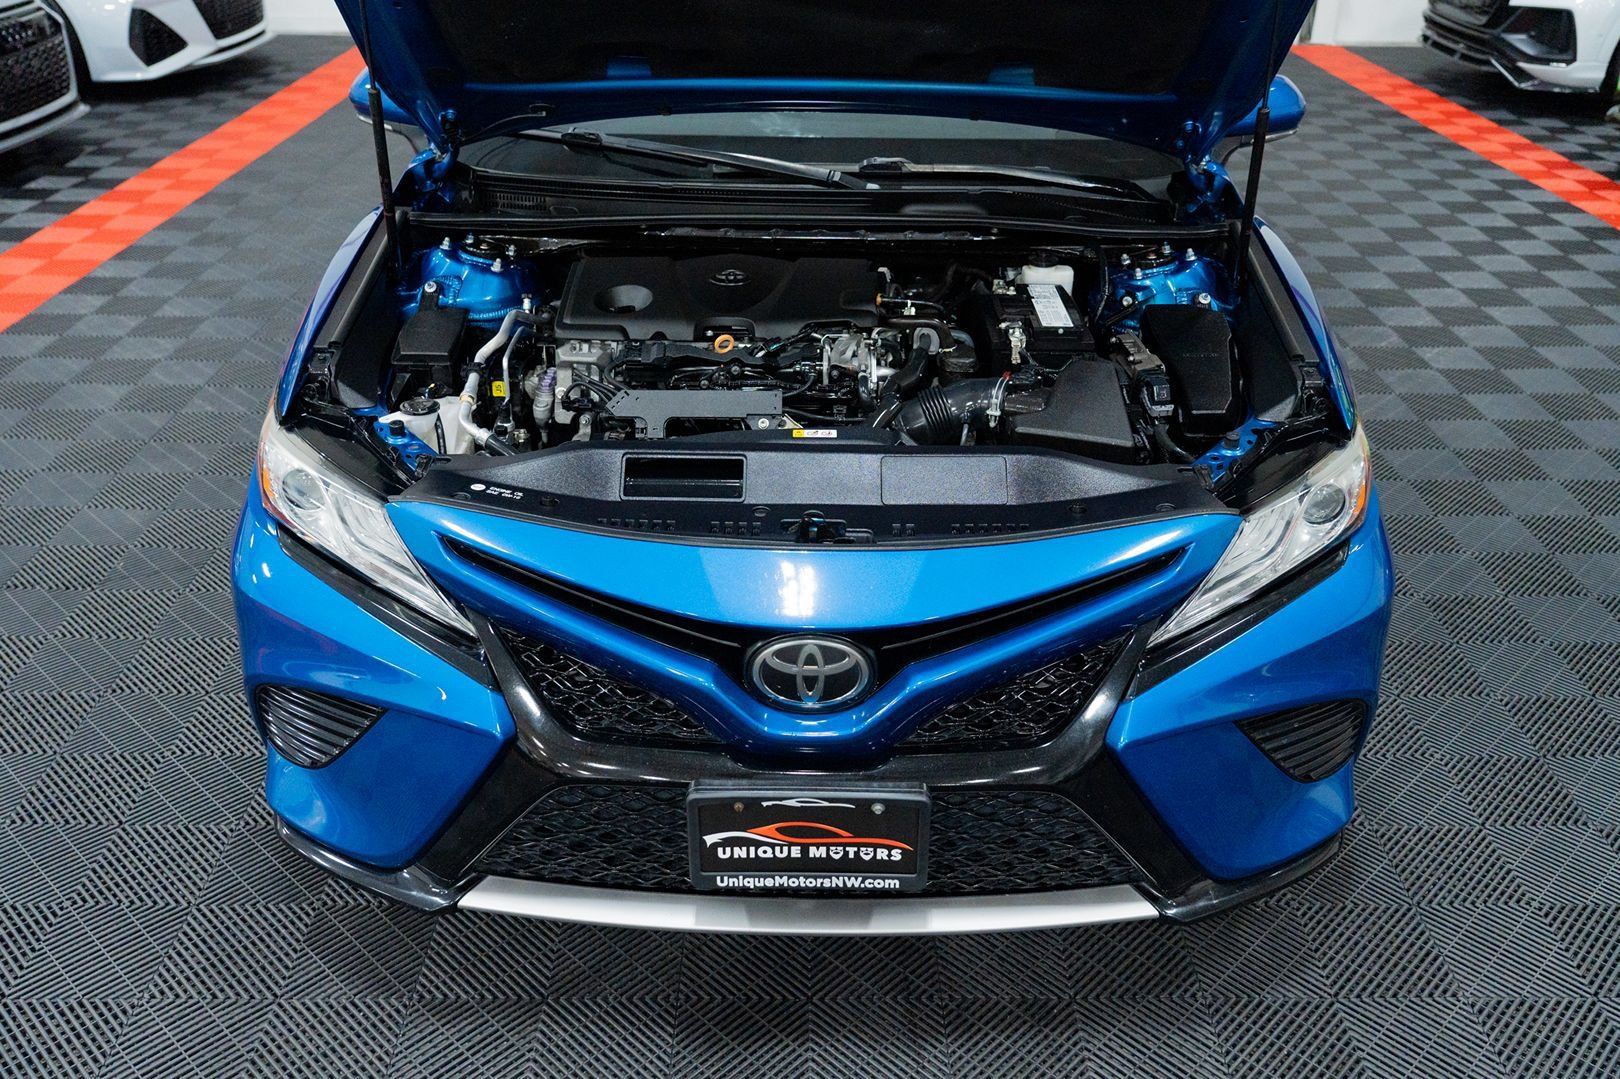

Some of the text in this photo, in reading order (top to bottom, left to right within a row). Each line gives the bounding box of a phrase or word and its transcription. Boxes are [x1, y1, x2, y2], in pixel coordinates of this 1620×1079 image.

[718, 846, 902, 861] UNIQUE MOTORS
[717, 875, 900, 889] UniqueMotorsNW.com
